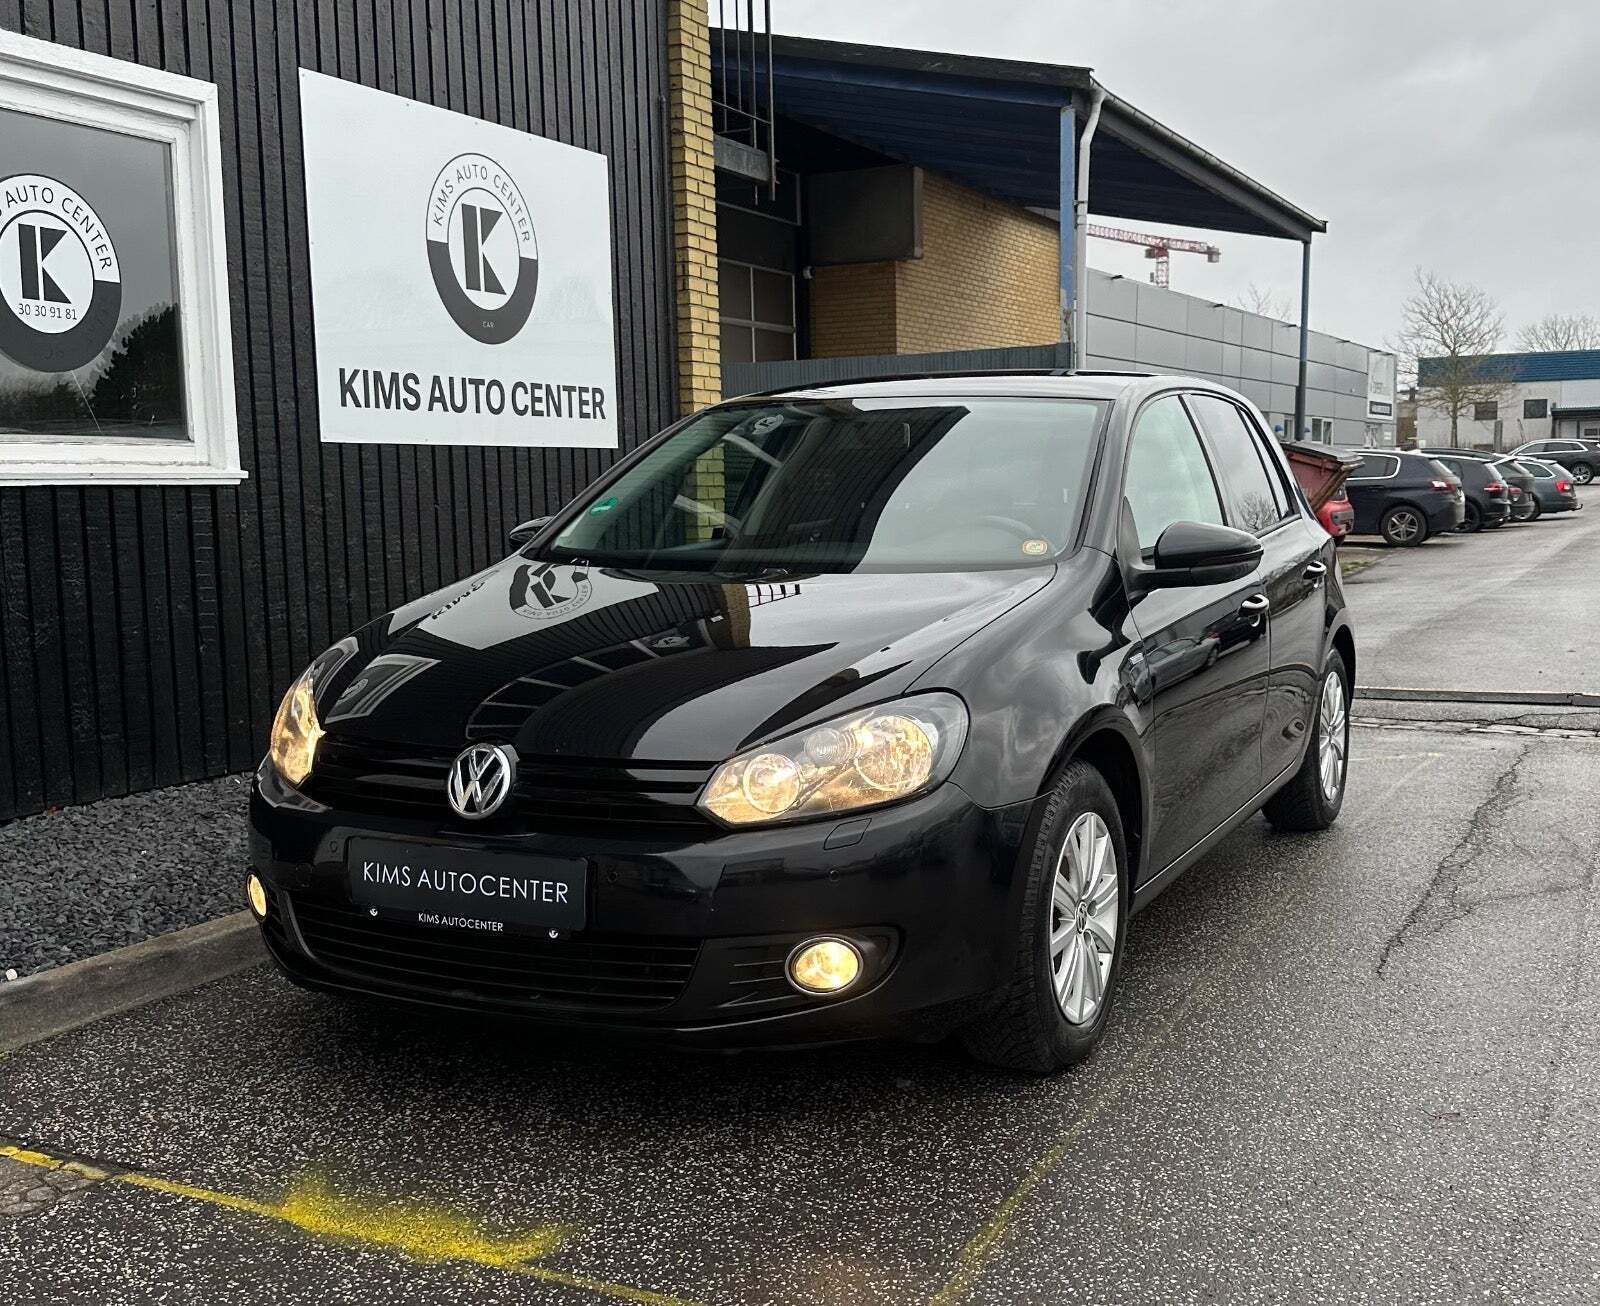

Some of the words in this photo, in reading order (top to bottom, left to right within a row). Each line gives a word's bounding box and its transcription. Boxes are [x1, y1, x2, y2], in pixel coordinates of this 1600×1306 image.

[4, 184, 55, 209] AUTO
[61, 197, 113, 270] CENTER
[433, 179, 455, 227] KIMS
[456, 164, 488, 184] AUTO
[493, 174, 530, 243] CENTER
[18, 303, 31, 317] 30
[34, 304, 47, 318] 30
[49, 306, 63, 320] 91
[64, 308, 78, 321] 81
[338, 366, 421, 412] KIMS
[427, 374, 506, 416] AUTO
[511, 380, 607, 420] CENTER
[362, 861, 411, 887] KIMS
[417, 868, 569, 904] AUTOCENTER
[417, 912, 440, 925] KIMS
[441, 916, 504, 933] AUTOCENTER
